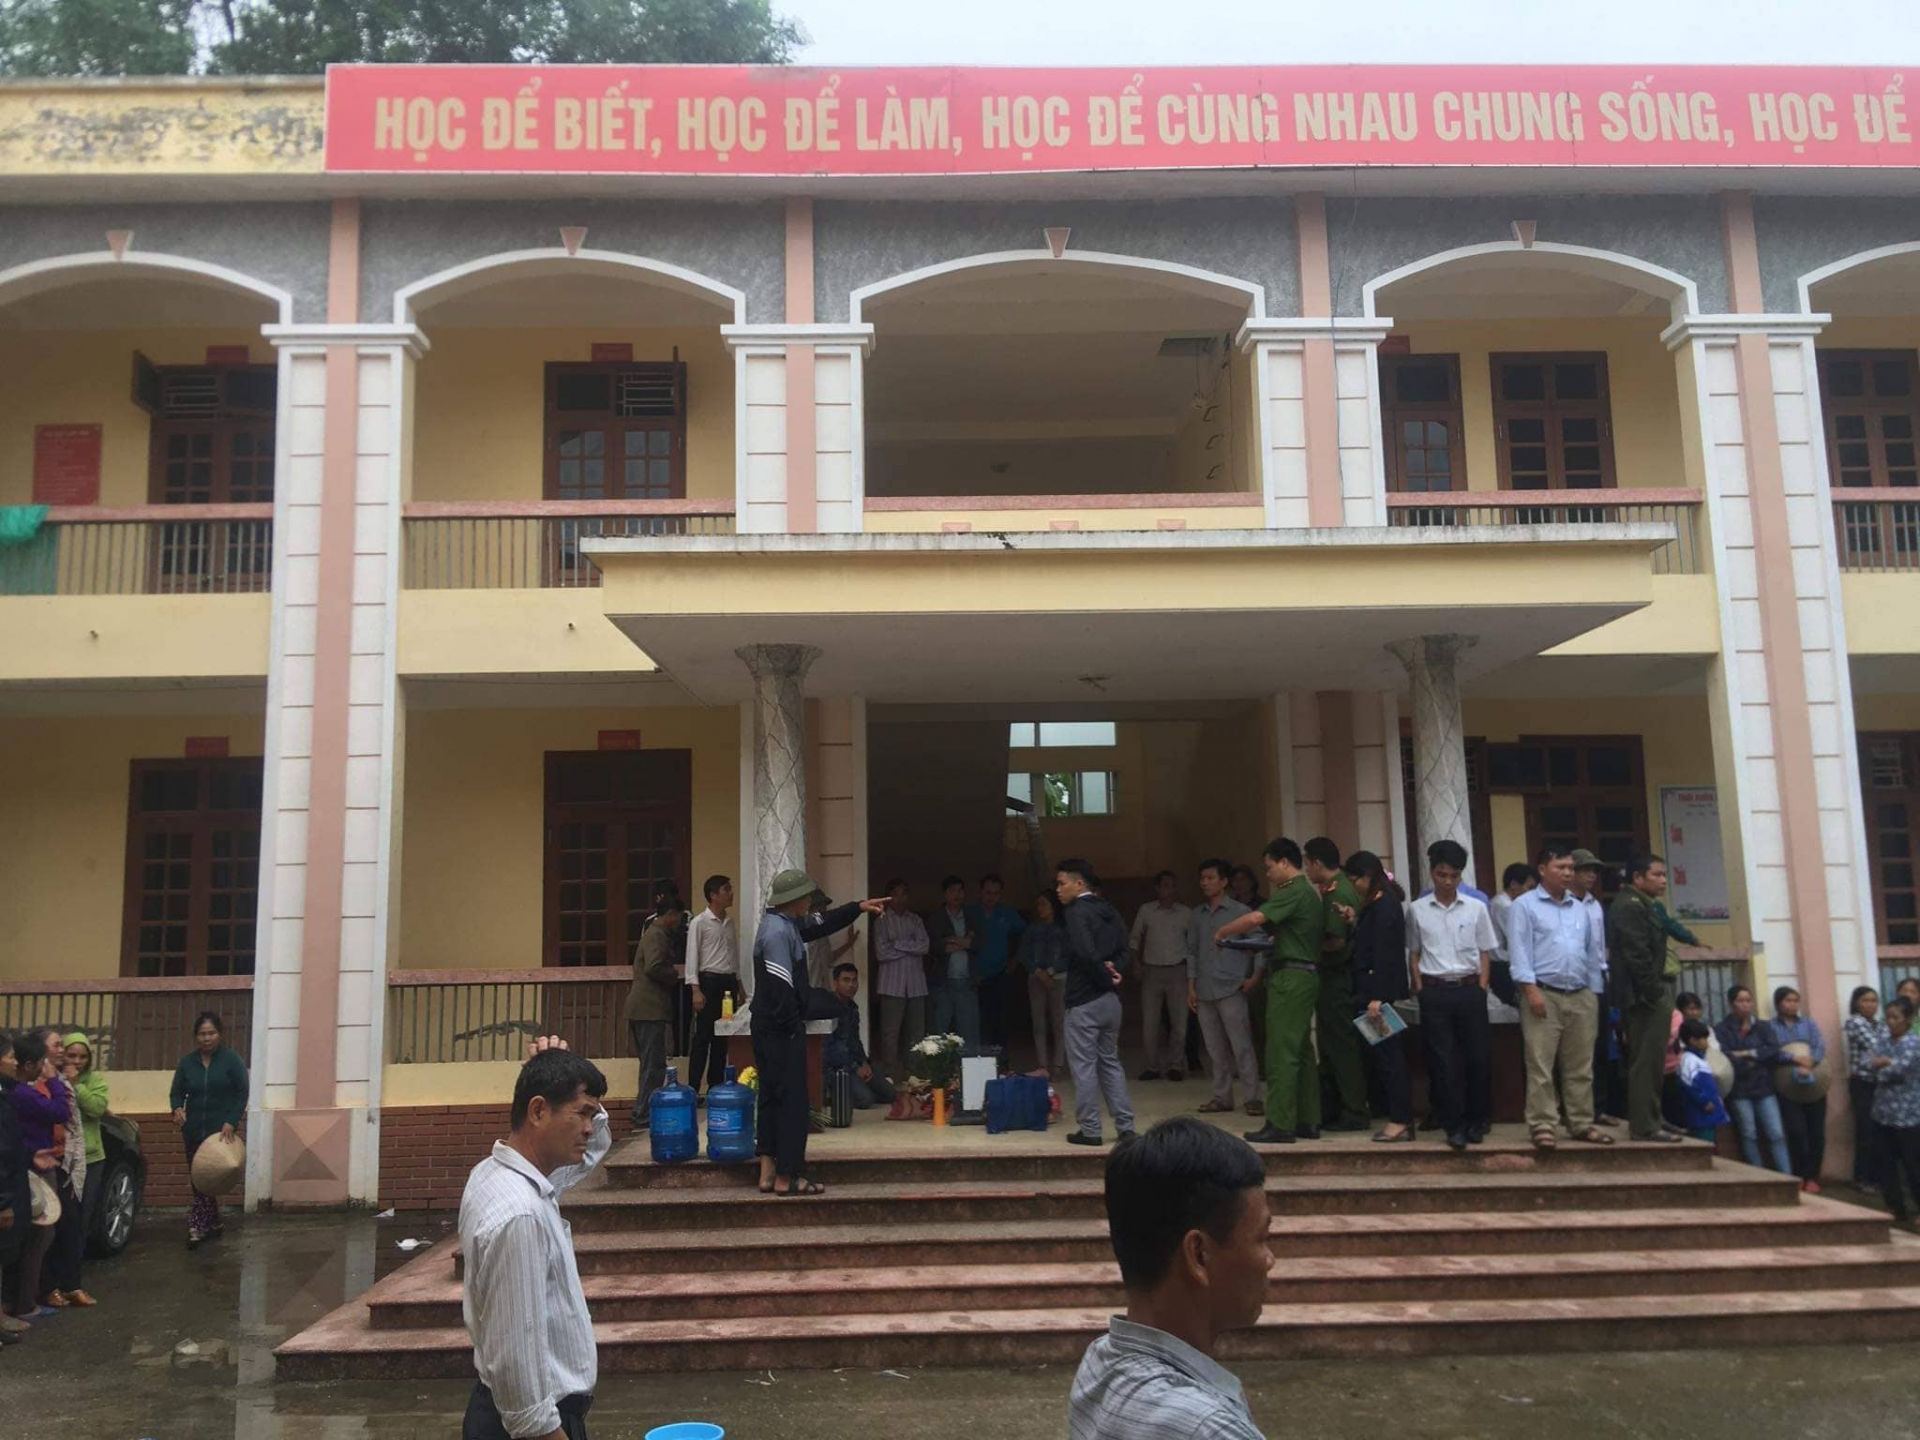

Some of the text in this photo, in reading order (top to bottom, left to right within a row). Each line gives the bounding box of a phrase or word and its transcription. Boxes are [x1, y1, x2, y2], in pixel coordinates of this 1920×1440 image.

[374, 74, 1911, 162] HỌC ĐỂ BIẾT, HỌC ĐỂ LÀM, HỌC ĐỂ CÙNG NHAU CHUNG SỐNG, HỌC ĐỂ
